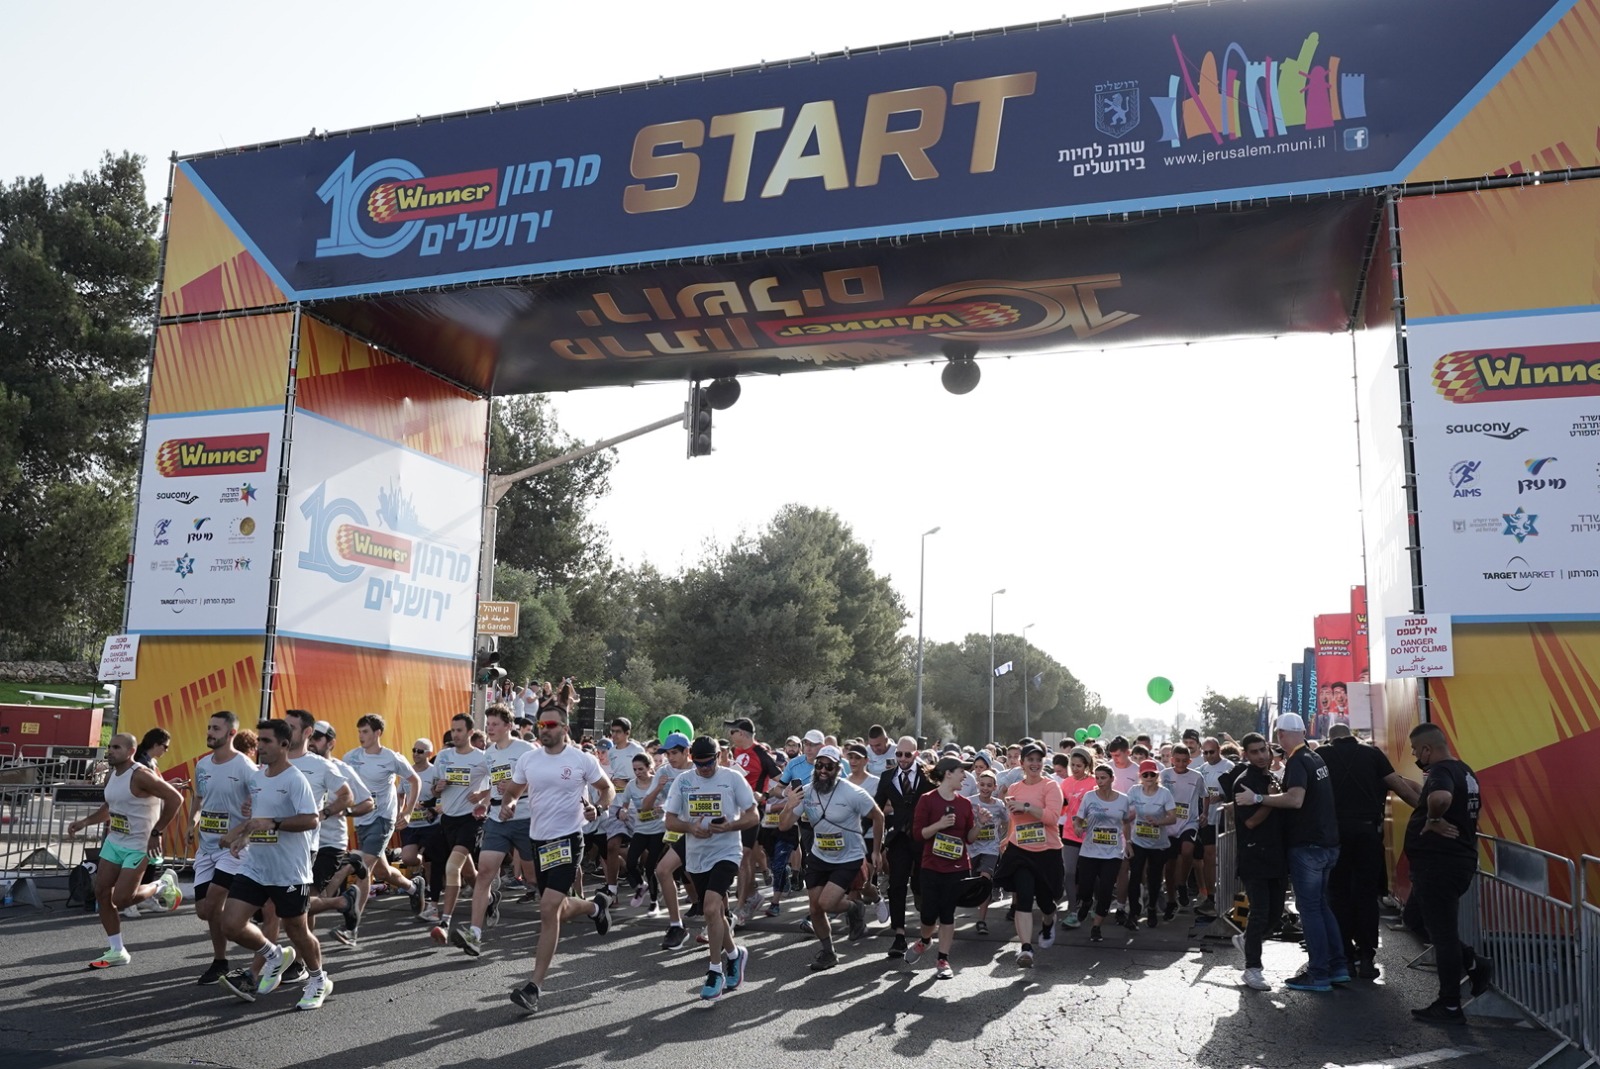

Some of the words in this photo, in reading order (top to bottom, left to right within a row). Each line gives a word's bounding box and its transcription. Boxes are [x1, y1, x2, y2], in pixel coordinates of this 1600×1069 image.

[1095, 80, 1139, 92] ירושלים
[623, 71, 1037, 214] START
[1108, 140, 1145, 157] שווה
[1058, 142, 1103, 162] לחיות
[1163, 135, 1327, 167] www.jerusalem.muni.il
[1073, 157, 1146, 177] בירושלים
[498, 154, 602, 206] מרתון
[397, 184, 491, 209] Winner
[419, 210, 553, 257] ירושלים
[781, 311, 970, 339] Winner
[1580, 415, 1600, 423] שרד
[1446, 422, 1510, 434] saucony
[1572, 423, 1600, 431] תרבות
[180, 444, 262, 466] Winner
[1517, 479, 1546, 494] עדן
[1548, 478, 1566, 490] מי
[156, 491, 191, 501] saucony
[1453, 488, 1481, 498] AIMS
[153, 538, 169, 546] AIMS
[353, 530, 409, 564] Winner
[410, 541, 472, 584] מרתון
[1519, 570, 1555, 579] MARKET
[1567, 569, 1599, 580] המרתון
[363, 574, 452, 622] ירושלים
[487, 622, 512, 631] Garden
[1405, 618, 1428, 626] סכנה
[1396, 626, 1422, 636] לטפס
[1424, 627, 1437, 636] אין
[1318, 637, 1350, 646] Winner
[1400, 638, 1434, 646] DANGER
[1390, 647, 1403, 655] DO
[1403, 646, 1420, 654] NOT
[1421, 645, 1448, 653] CLIMB
[1411, 655, 1426, 664] خطر
[1420, 665, 1443, 673] ممنوع
